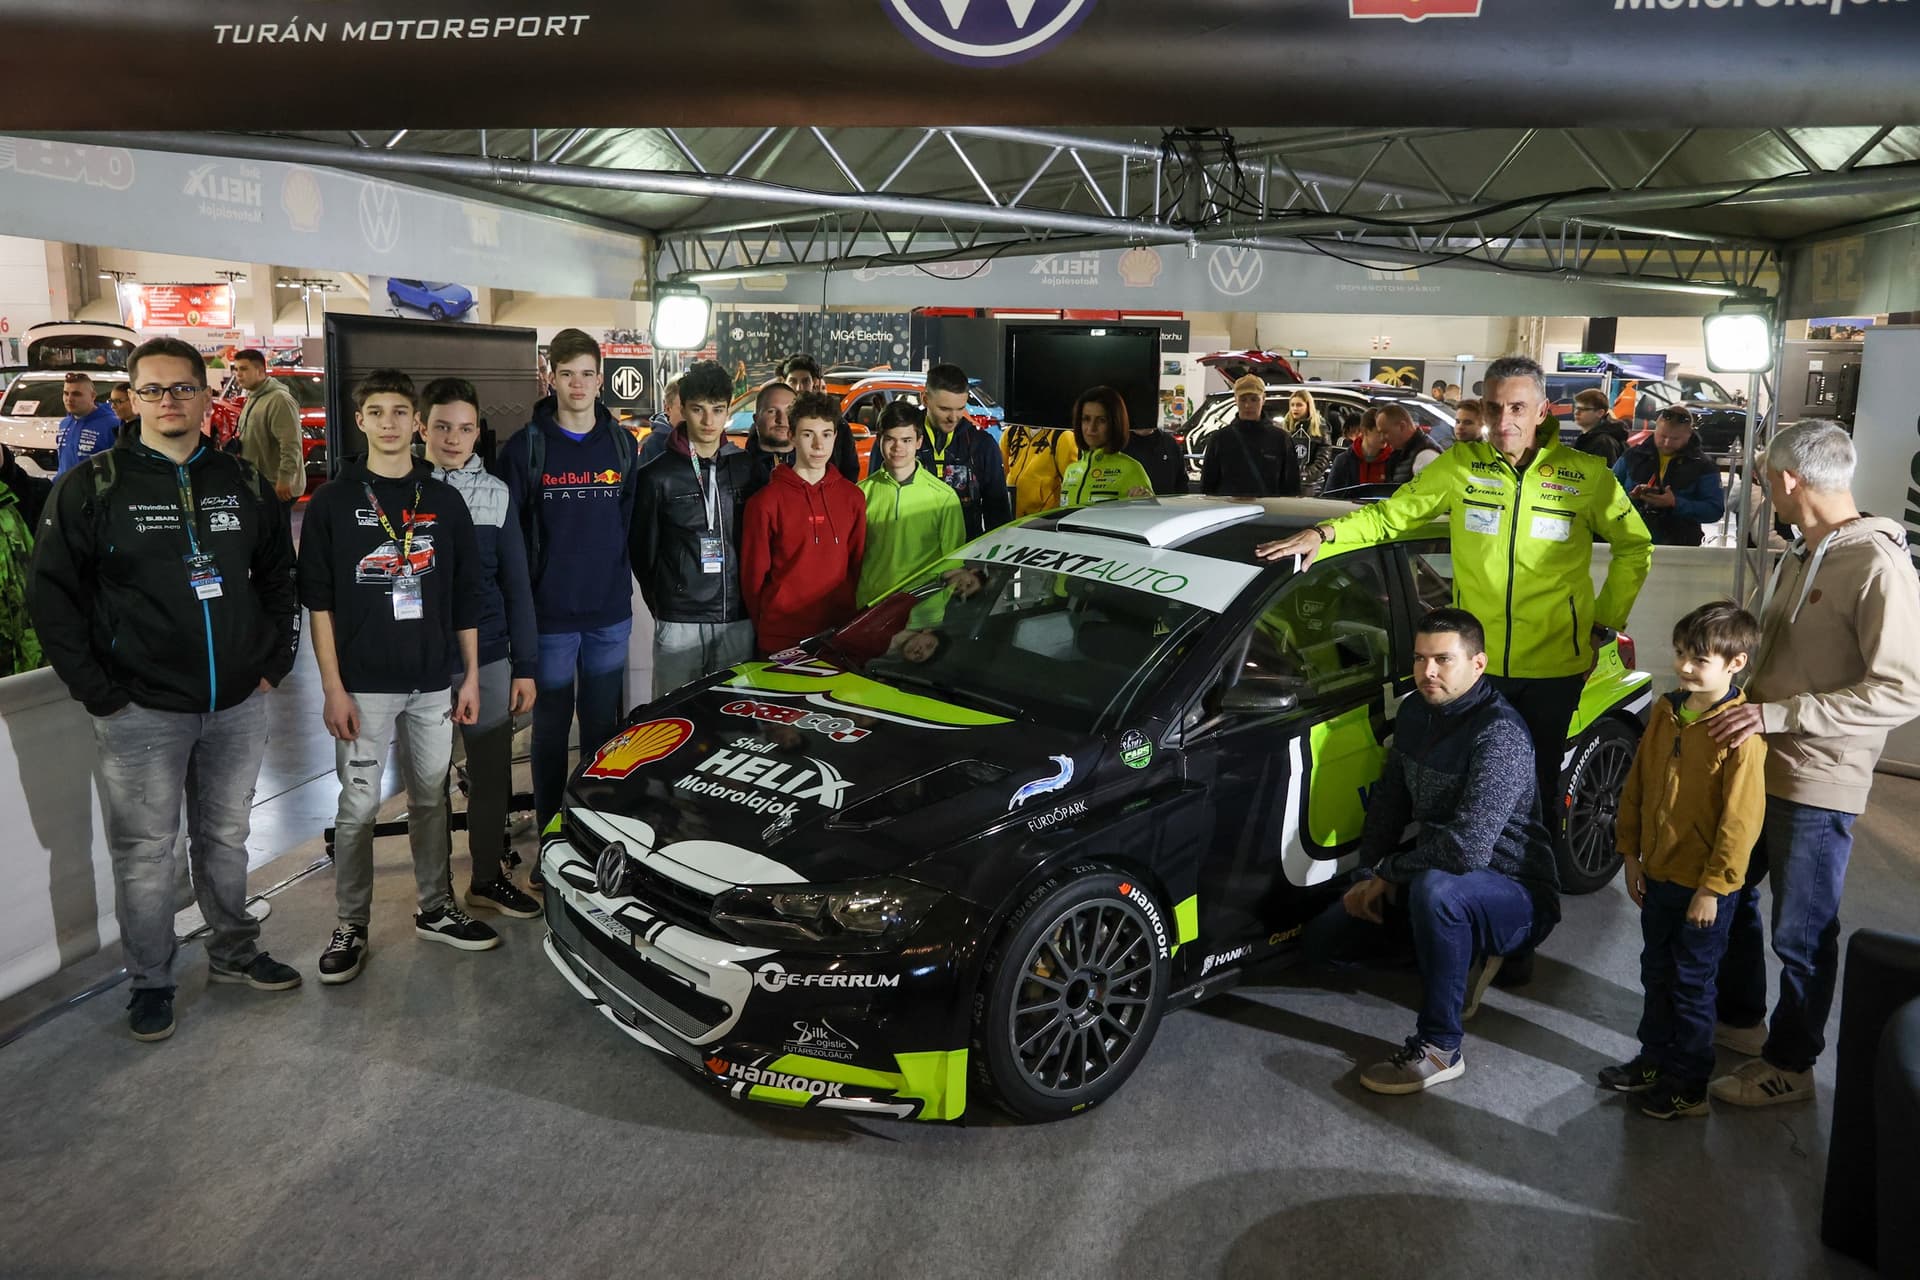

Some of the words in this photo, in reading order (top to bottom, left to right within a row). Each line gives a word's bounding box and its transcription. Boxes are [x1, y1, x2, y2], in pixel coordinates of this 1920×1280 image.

[213, 15, 328, 44] TURÁN
[341, 15, 591, 42] MOTORSPORT
[830, 330, 855, 341] MG4
[857, 330, 894, 342] Electric
[614, 368, 641, 397] MG
[543, 472, 567, 486] Red
[568, 471, 591, 485] Bull
[730, 736, 779, 754] Shell
[694, 748, 856, 810] HELIX
[673, 774, 800, 818] Motorolajok
[1027, 799, 1089, 832] FÜRDŐPARK
[792, 1020, 829, 1043] Silk
